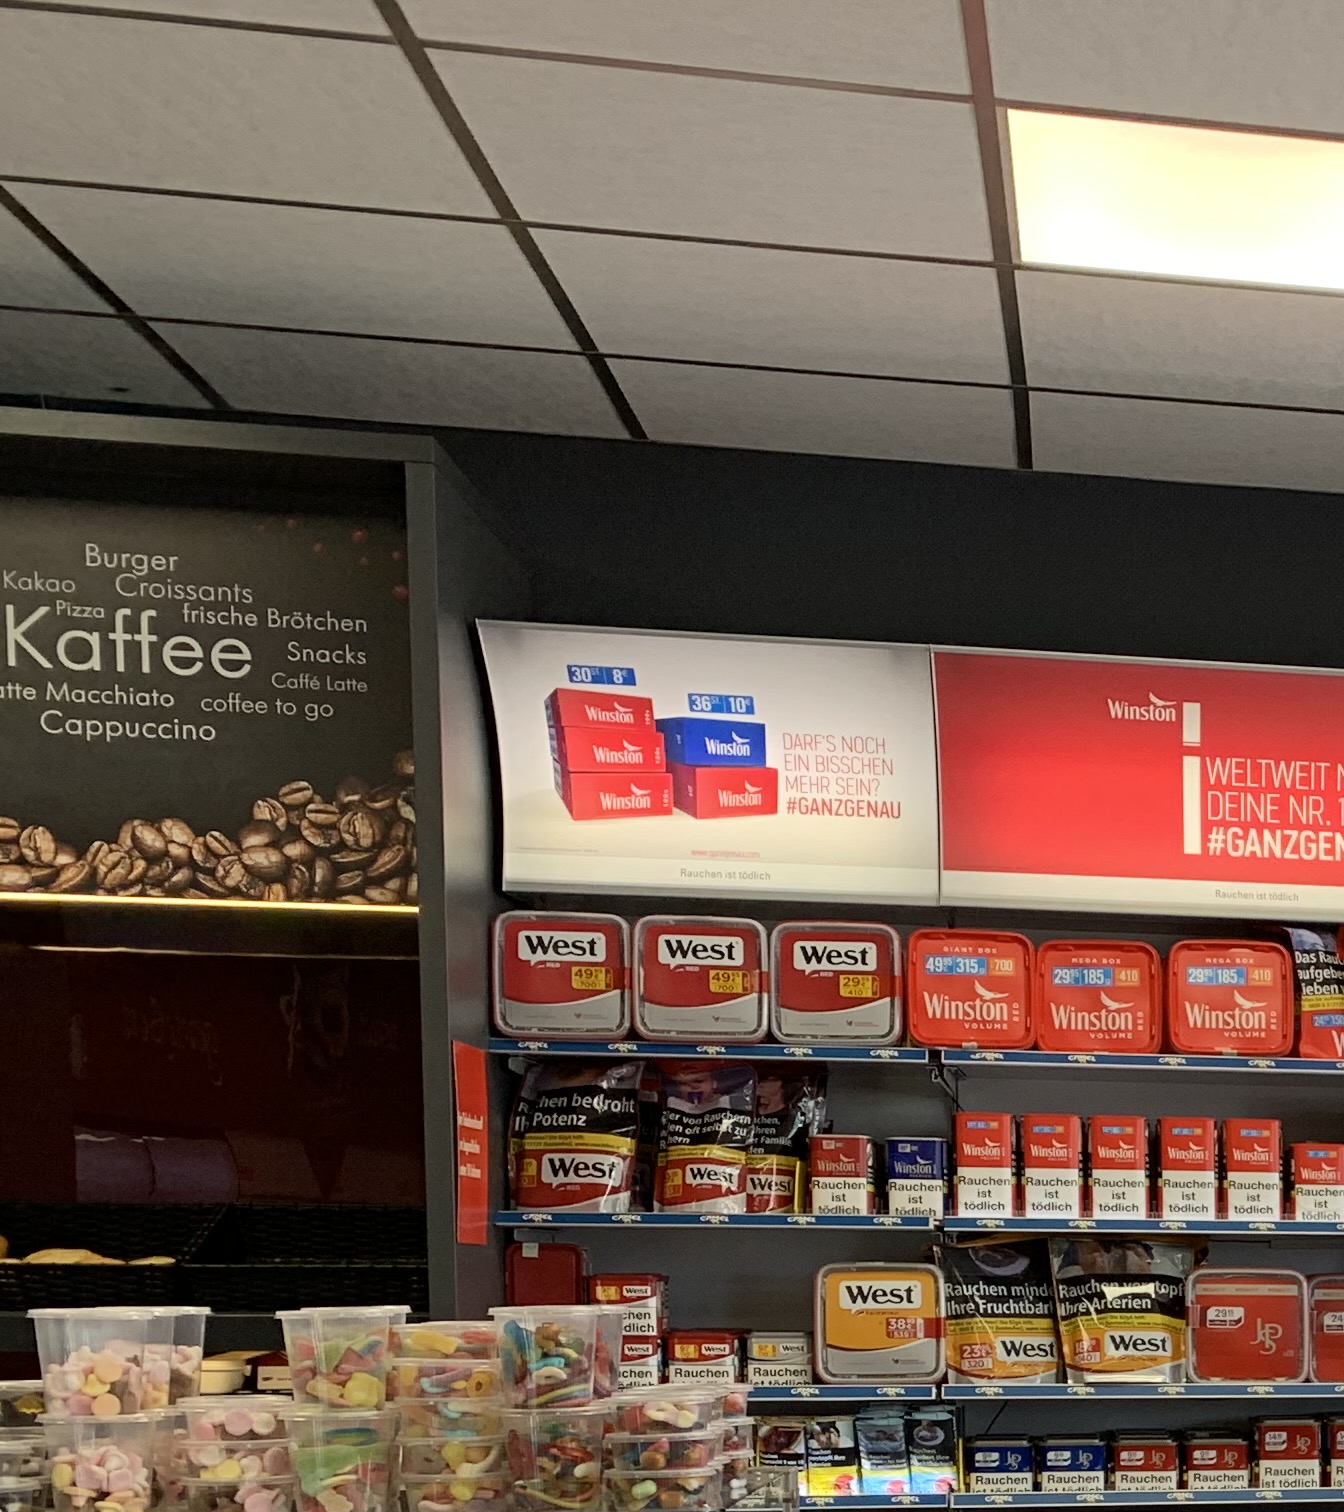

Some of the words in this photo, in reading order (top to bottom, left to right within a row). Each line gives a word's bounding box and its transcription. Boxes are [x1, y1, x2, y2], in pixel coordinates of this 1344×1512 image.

[85, 543, 179, 576] Burger
[3, 570, 76, 594] Kakao
[115, 573, 253, 604] Croissants
[56, 600, 105, 619] Pizza
[182, 603, 258, 627] frische
[267, 608, 367, 633] Brötchen
[4, 603, 253, 679] Kaffee
[287, 642, 367, 665] Snacks
[272, 672, 320, 691] Caffé
[327, 675, 368, 693] Latte
[46, 682, 175, 708] Macchiato
[200, 692, 267, 715] coffee
[276, 698, 296, 716] to
[305, 700, 334, 721] go
[1108, 699, 1176, 723] Winston
[40, 710, 217, 743] Cappuccino
[782, 732, 836, 753] DARF'S
[841, 734, 886, 754] NOCH
[784, 754, 810, 772] EIN
[815, 755, 894, 776] BISSCHEN
[1206, 756, 1329, 792] WELTWEIT
[785, 775, 829, 794] MEHR
[835, 777, 880, 796] SEIN?
[786, 796, 901, 820] #GANZGENAU
[1207, 791, 1280, 823] DEINE
[1288, 795, 1331, 826] NR.
[525, 934, 597, 958] West
[665, 939, 736, 962] West
[800, 944, 869, 967] West
[923, 991, 1008, 1021] Winston
[958, 1175, 1010, 1188] Rauchen
[977, 1188, 992, 1199] ist
[964, 1200, 1005, 1212] tödlich
[845, 1285, 915, 1305] West
[1109, 1334, 1168, 1353] West
